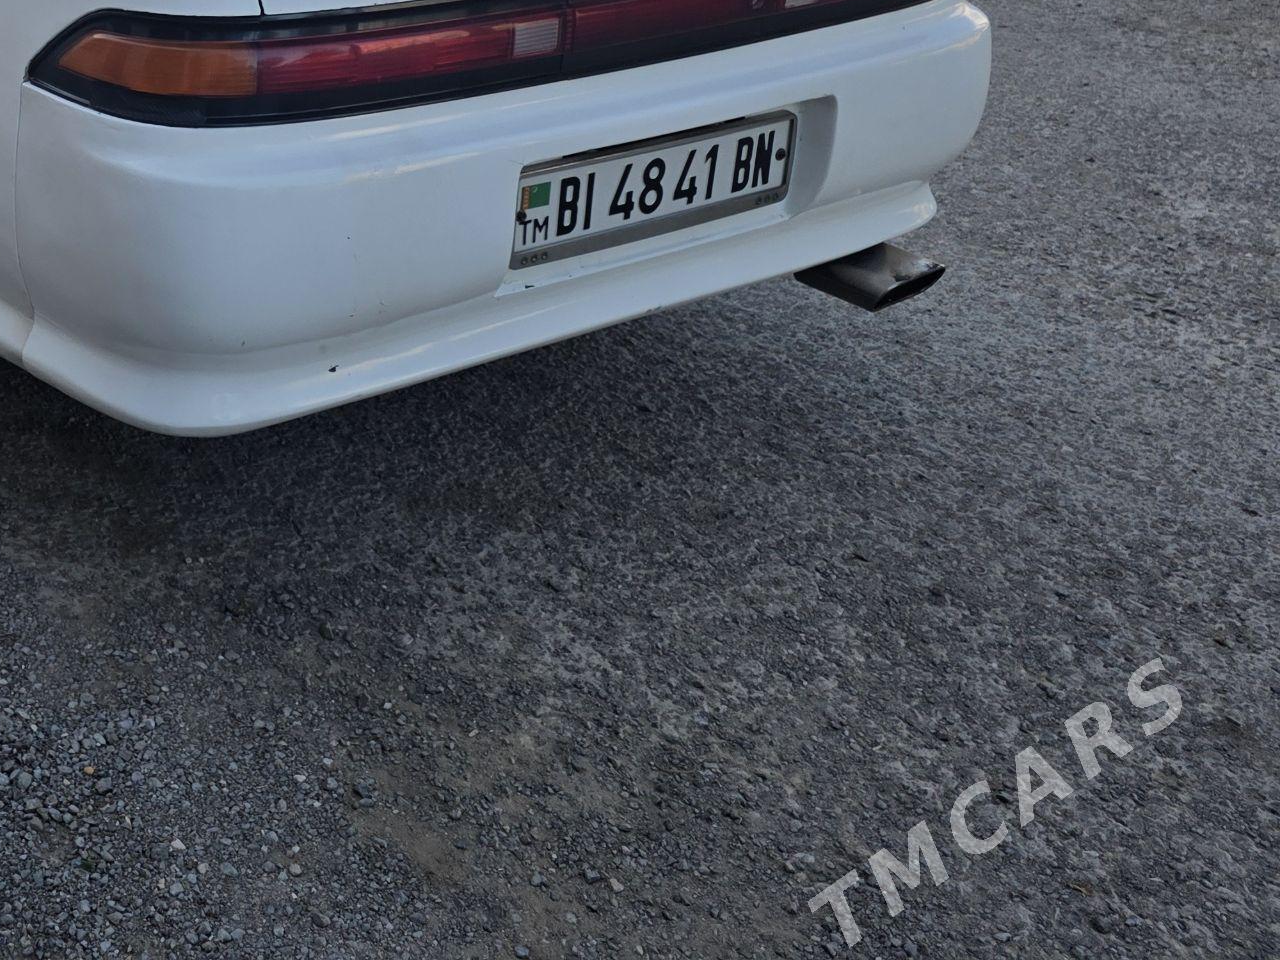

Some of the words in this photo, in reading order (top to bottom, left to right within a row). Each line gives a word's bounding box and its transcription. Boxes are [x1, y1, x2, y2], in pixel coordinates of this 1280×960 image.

[520, 216, 549, 245] TM
[556, 172, 596, 236] BI
[608, 143, 720, 221] 4841
[731, 130, 775, 193] BN
